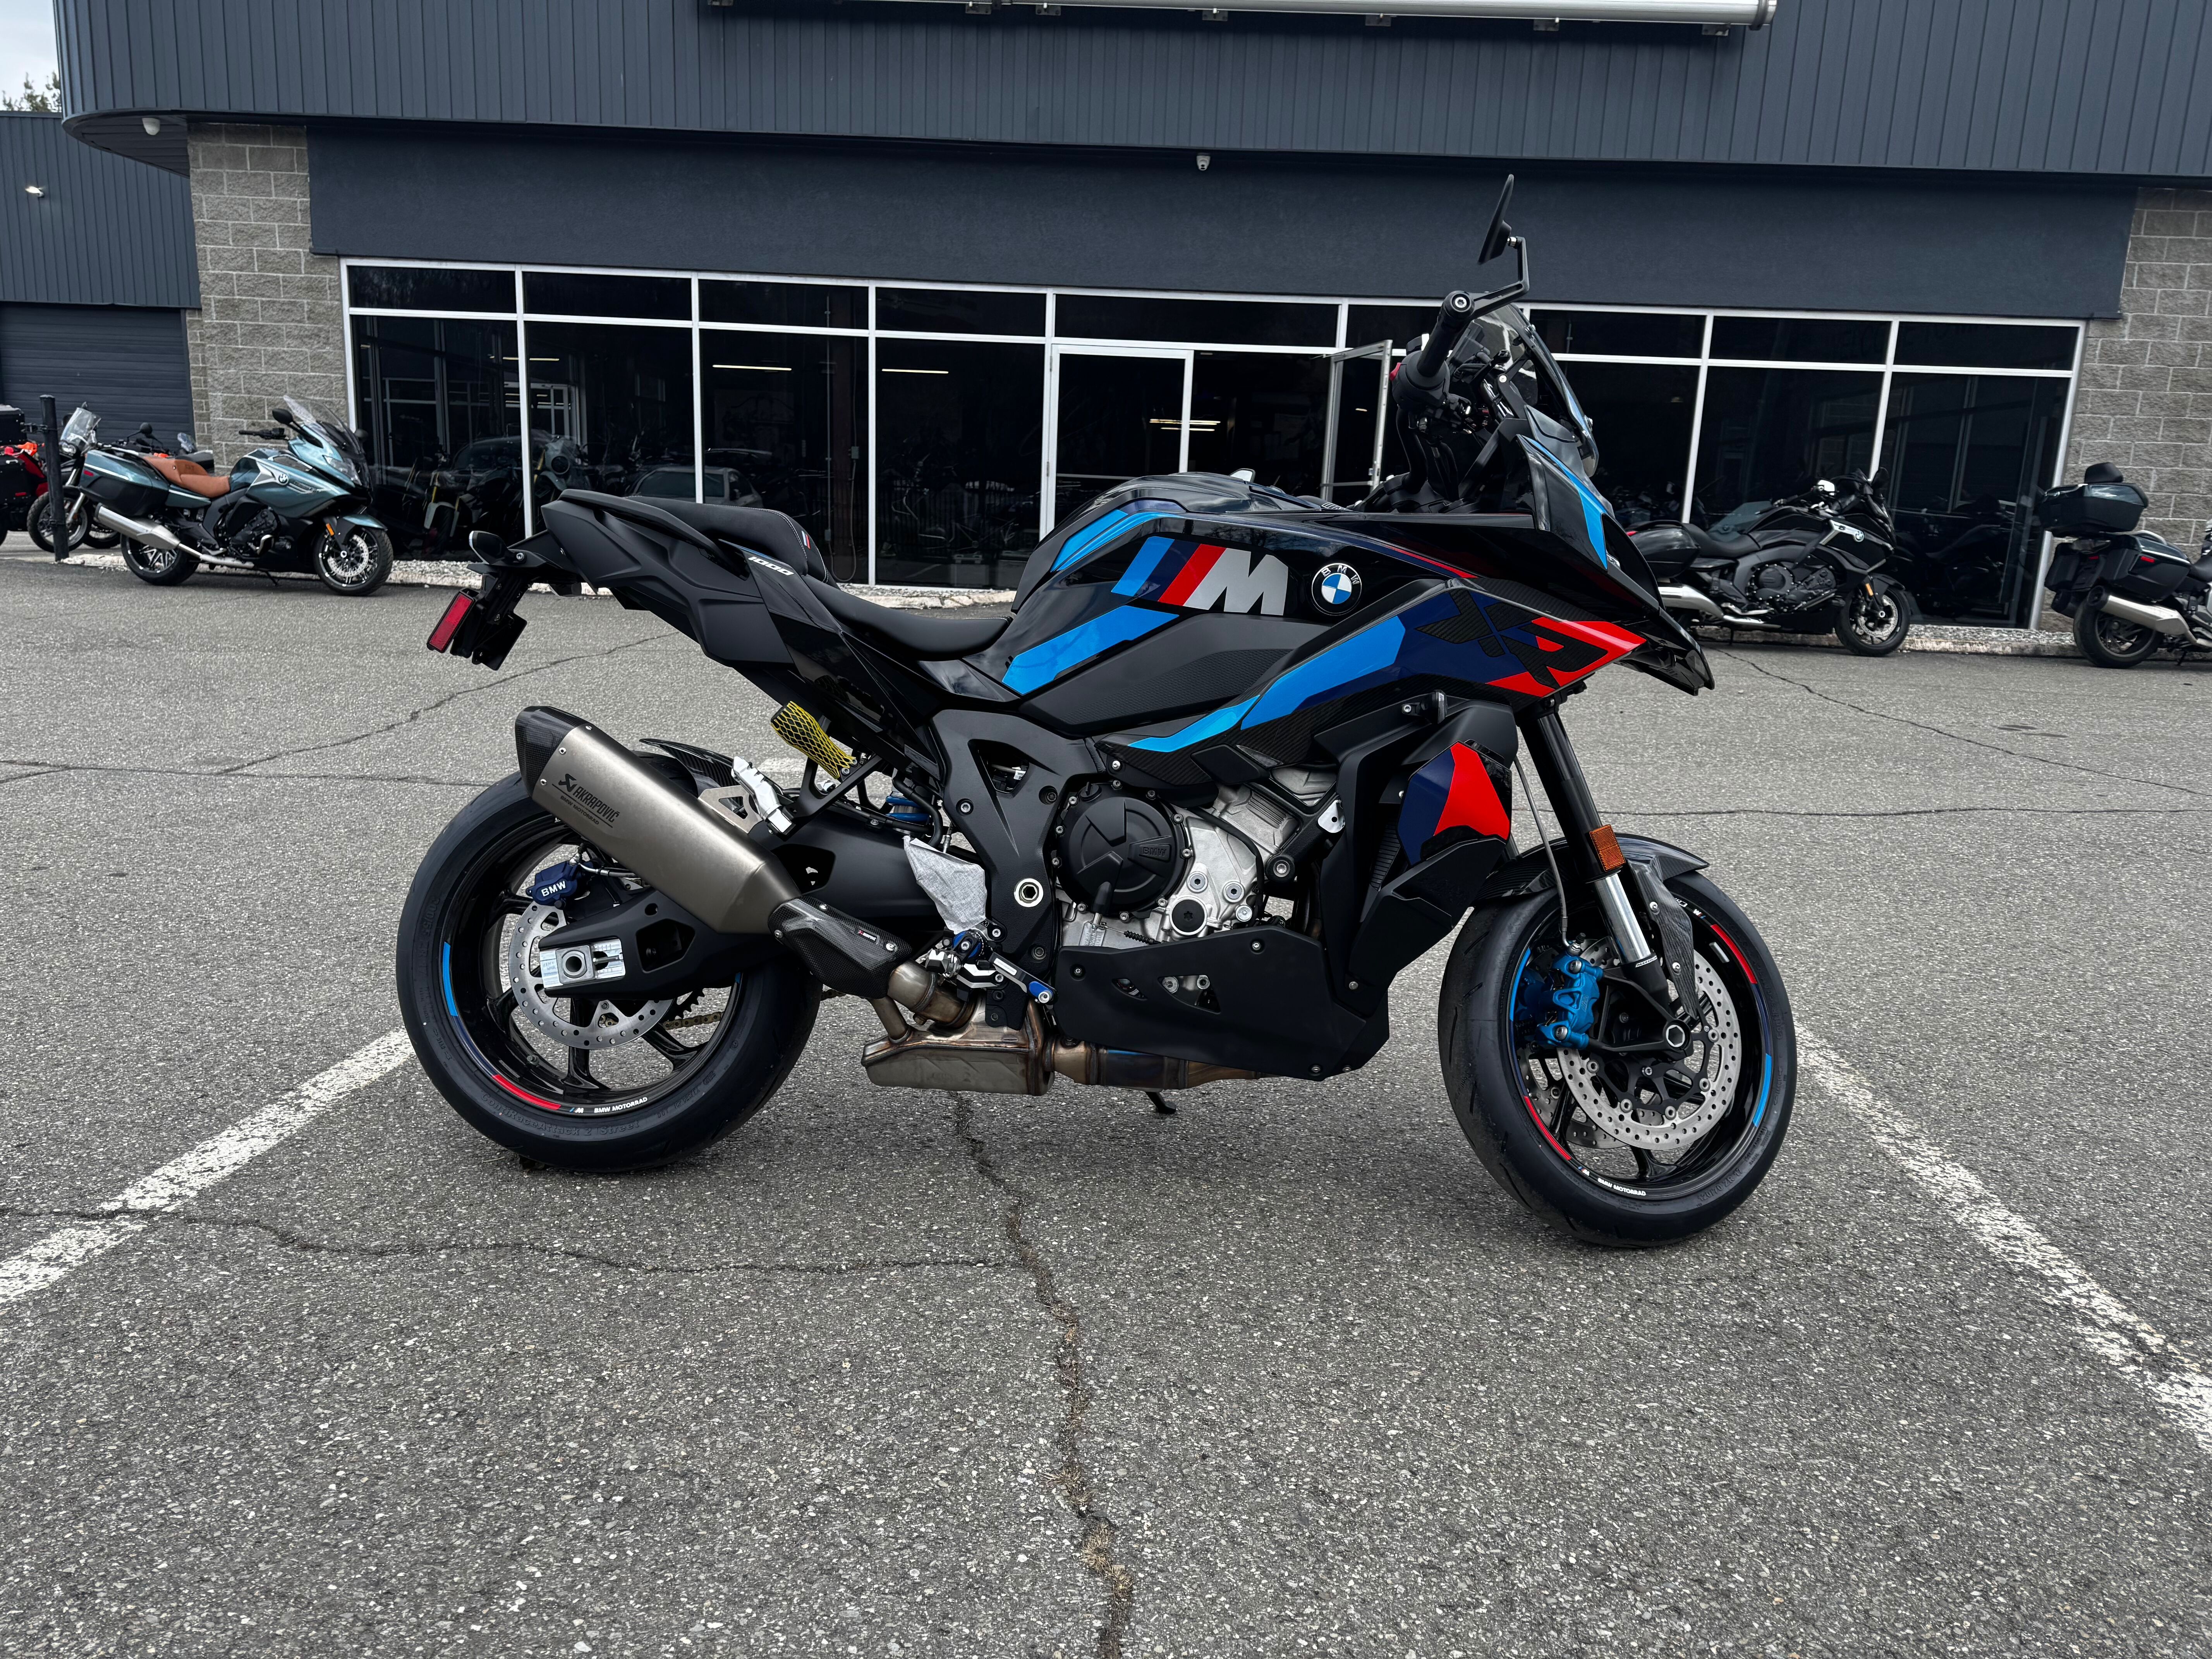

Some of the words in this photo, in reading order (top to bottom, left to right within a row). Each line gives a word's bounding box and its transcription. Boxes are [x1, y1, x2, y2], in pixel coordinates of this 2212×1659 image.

[748, 556, 794, 575] 1000
[1183, 547, 1288, 616] M
[560, 795, 573, 805] BMW
[573, 804, 599, 825] MOTORRAD
[1143, 847, 1167, 856] BMW
[541, 880, 566, 897] BMW
[612, 1097, 648, 1111] MOTORRAD
[481, 1093, 580, 1136] ContiRaceAttack
[585, 1127, 592, 1135] 2
[600, 1120, 640, 1135] Street
[1598, 1178, 1613, 1188] BMW
[1613, 1184, 1646, 1196] MOTORRAD
